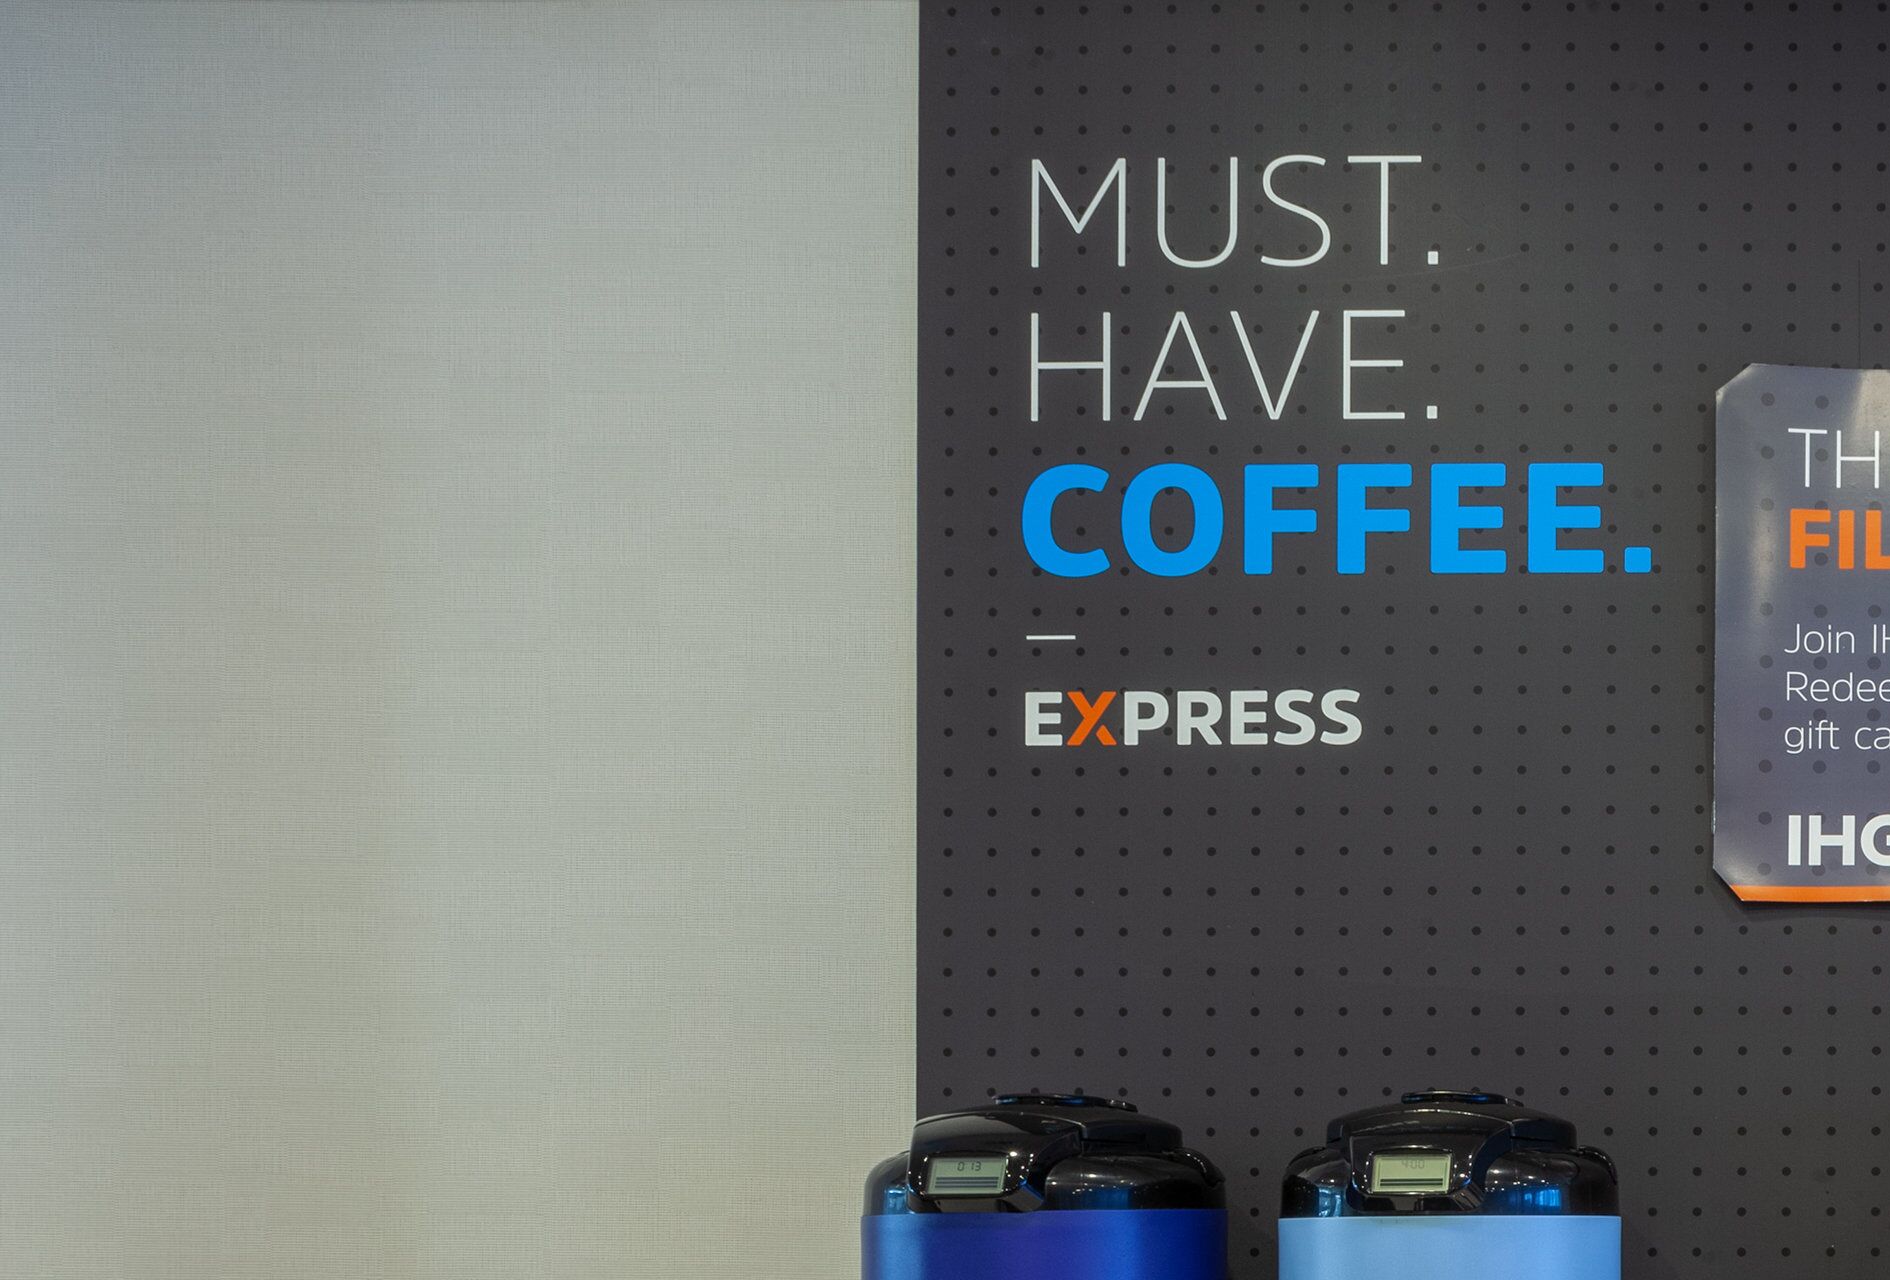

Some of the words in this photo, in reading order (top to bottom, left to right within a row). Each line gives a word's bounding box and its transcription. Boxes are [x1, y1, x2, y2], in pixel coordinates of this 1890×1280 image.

[1030, 154, 1439, 268] MUST.
[1030, 309, 1438, 422] HAVE.
[1021, 462, 1652, 578] COFFEE.
[1784, 623, 1856, 655] Join
[1025, 688, 1363, 747] EXPRESS
[1783, 719, 1841, 755] gift
